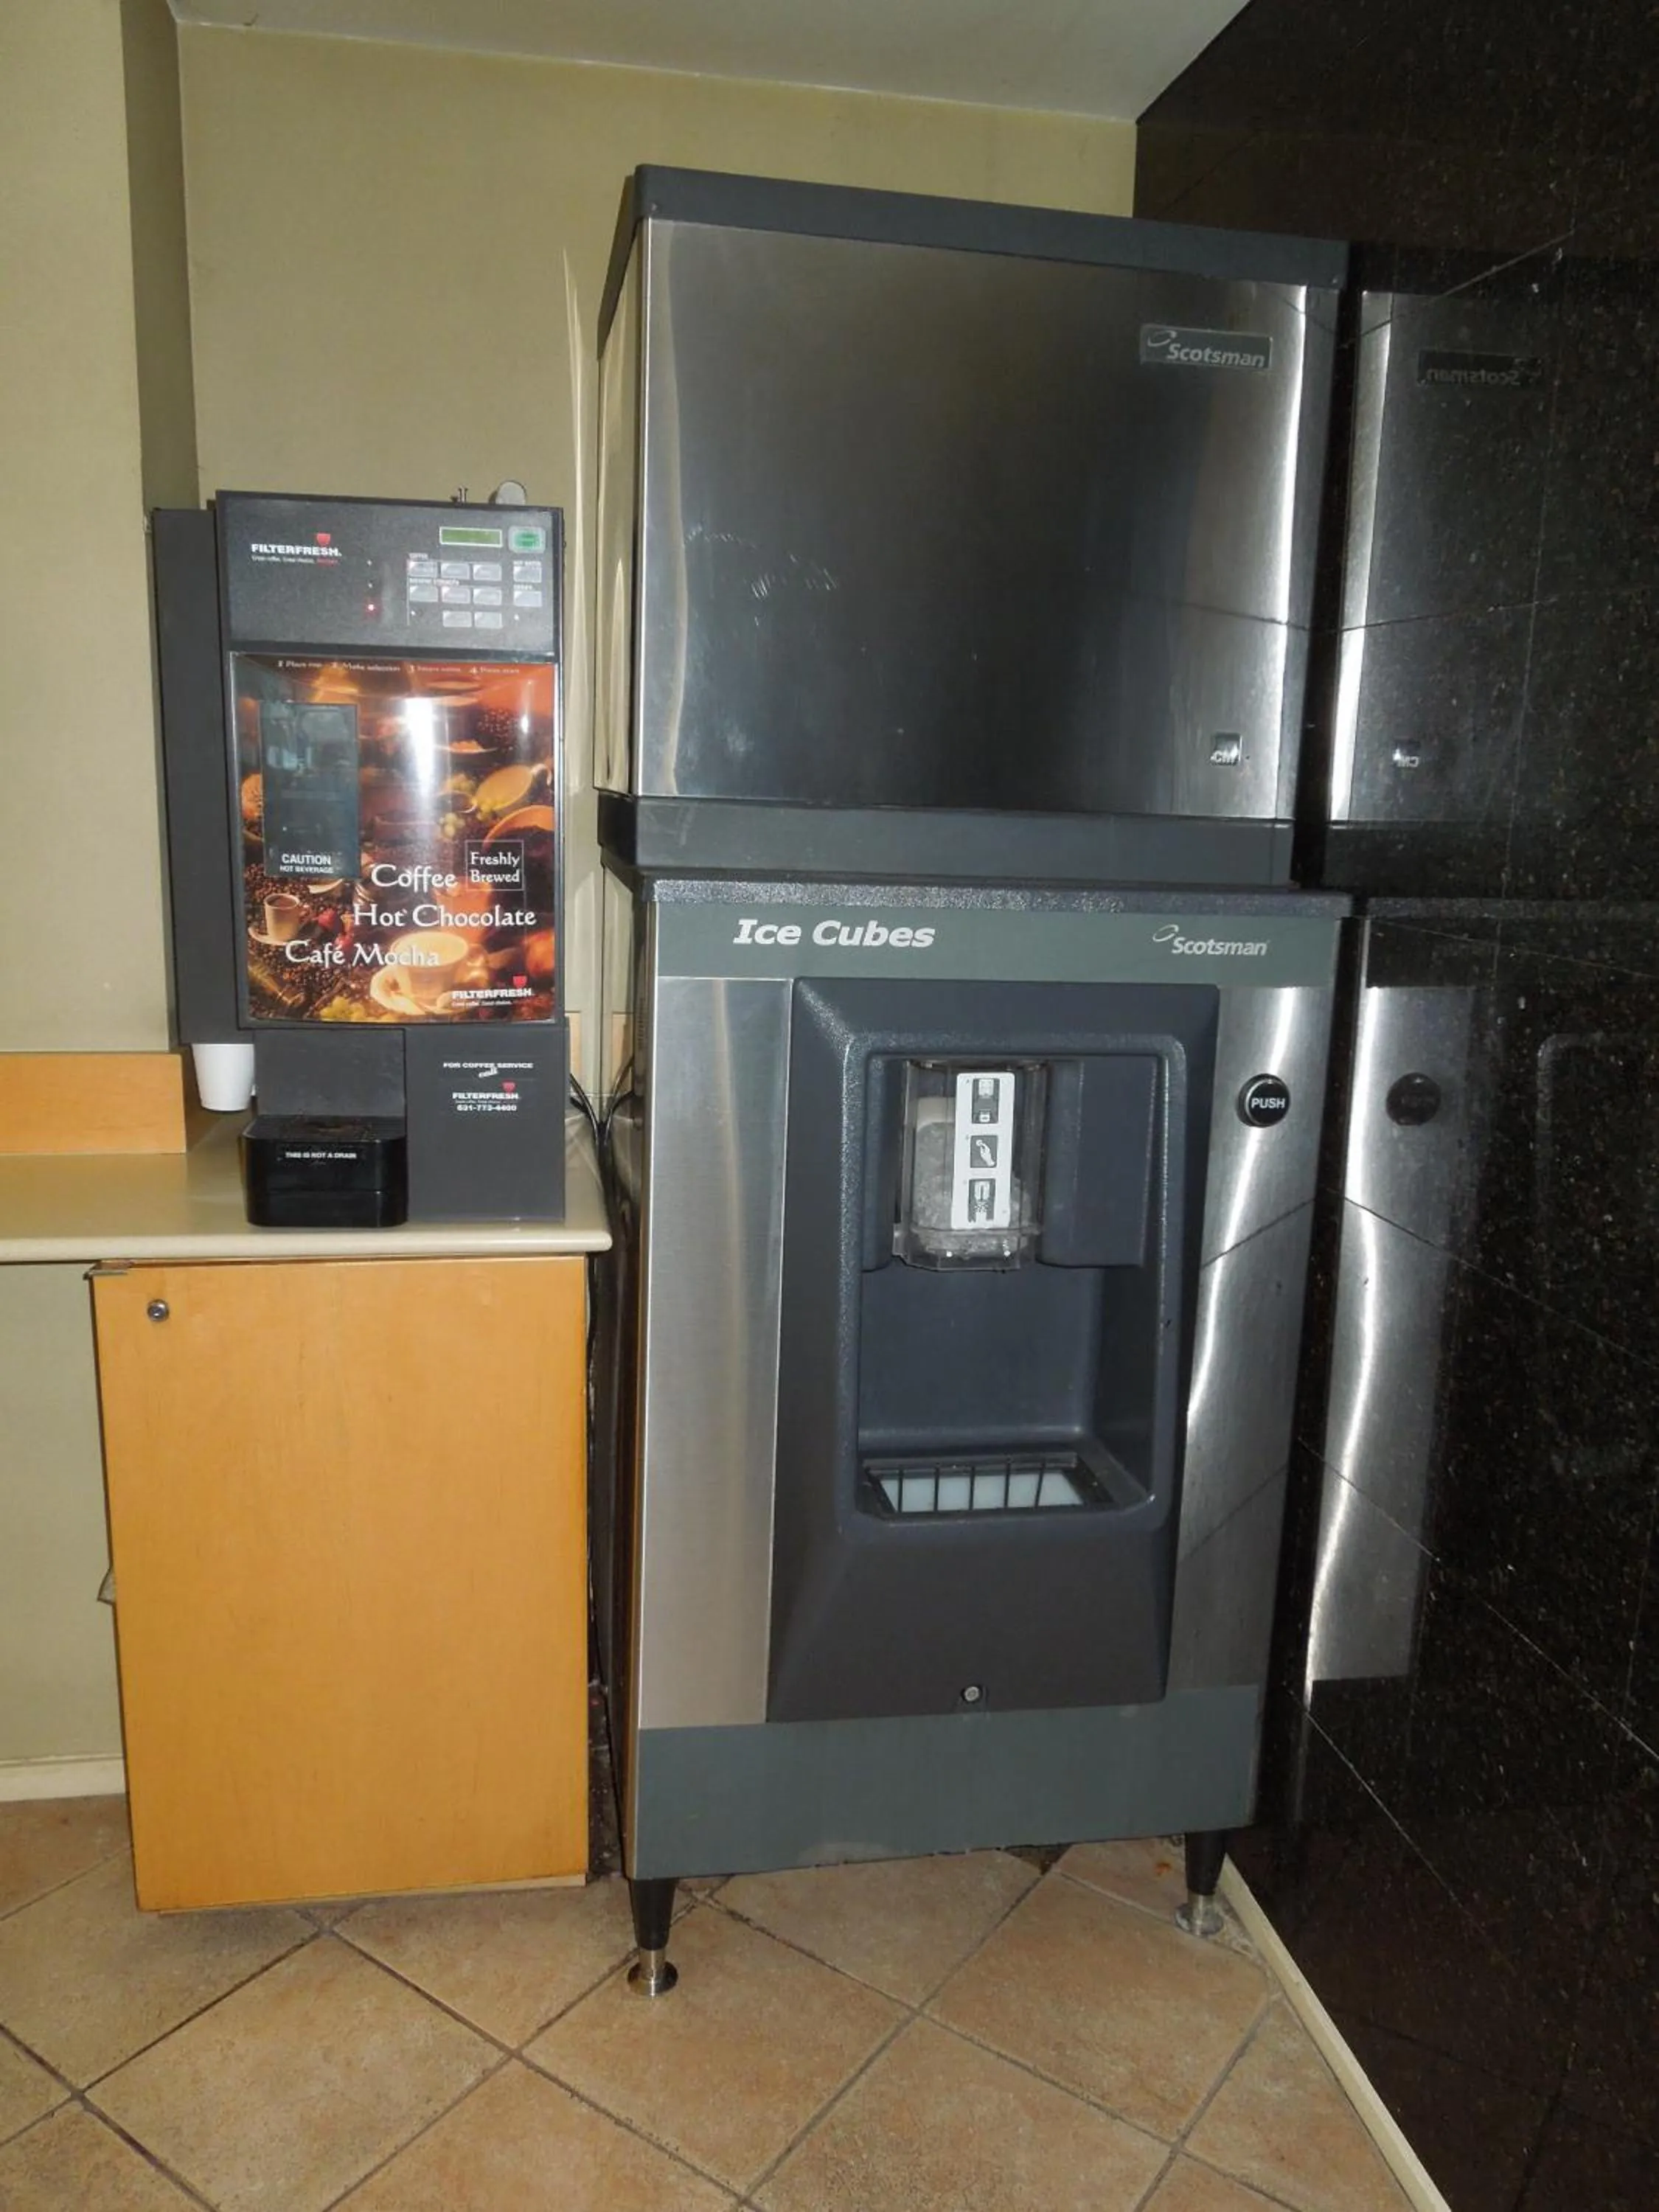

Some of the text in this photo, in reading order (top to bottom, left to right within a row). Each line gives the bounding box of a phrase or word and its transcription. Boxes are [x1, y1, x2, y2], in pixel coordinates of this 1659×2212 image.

[1166, 343, 1265, 368] Scotsman
[282, 853, 331, 866] CAUTION
[470, 851, 520, 868] Freshly
[371, 863, 459, 893] Coffee
[470, 869, 520, 883] Brewed
[353, 904, 538, 927] Hot Chocolate
[733, 919, 936, 947] Ice Cubes
[285, 940, 440, 968] Café Mocha
[1171, 936, 1267, 956] Scotsman
[1251, 1097, 1285, 1108] PUSH
